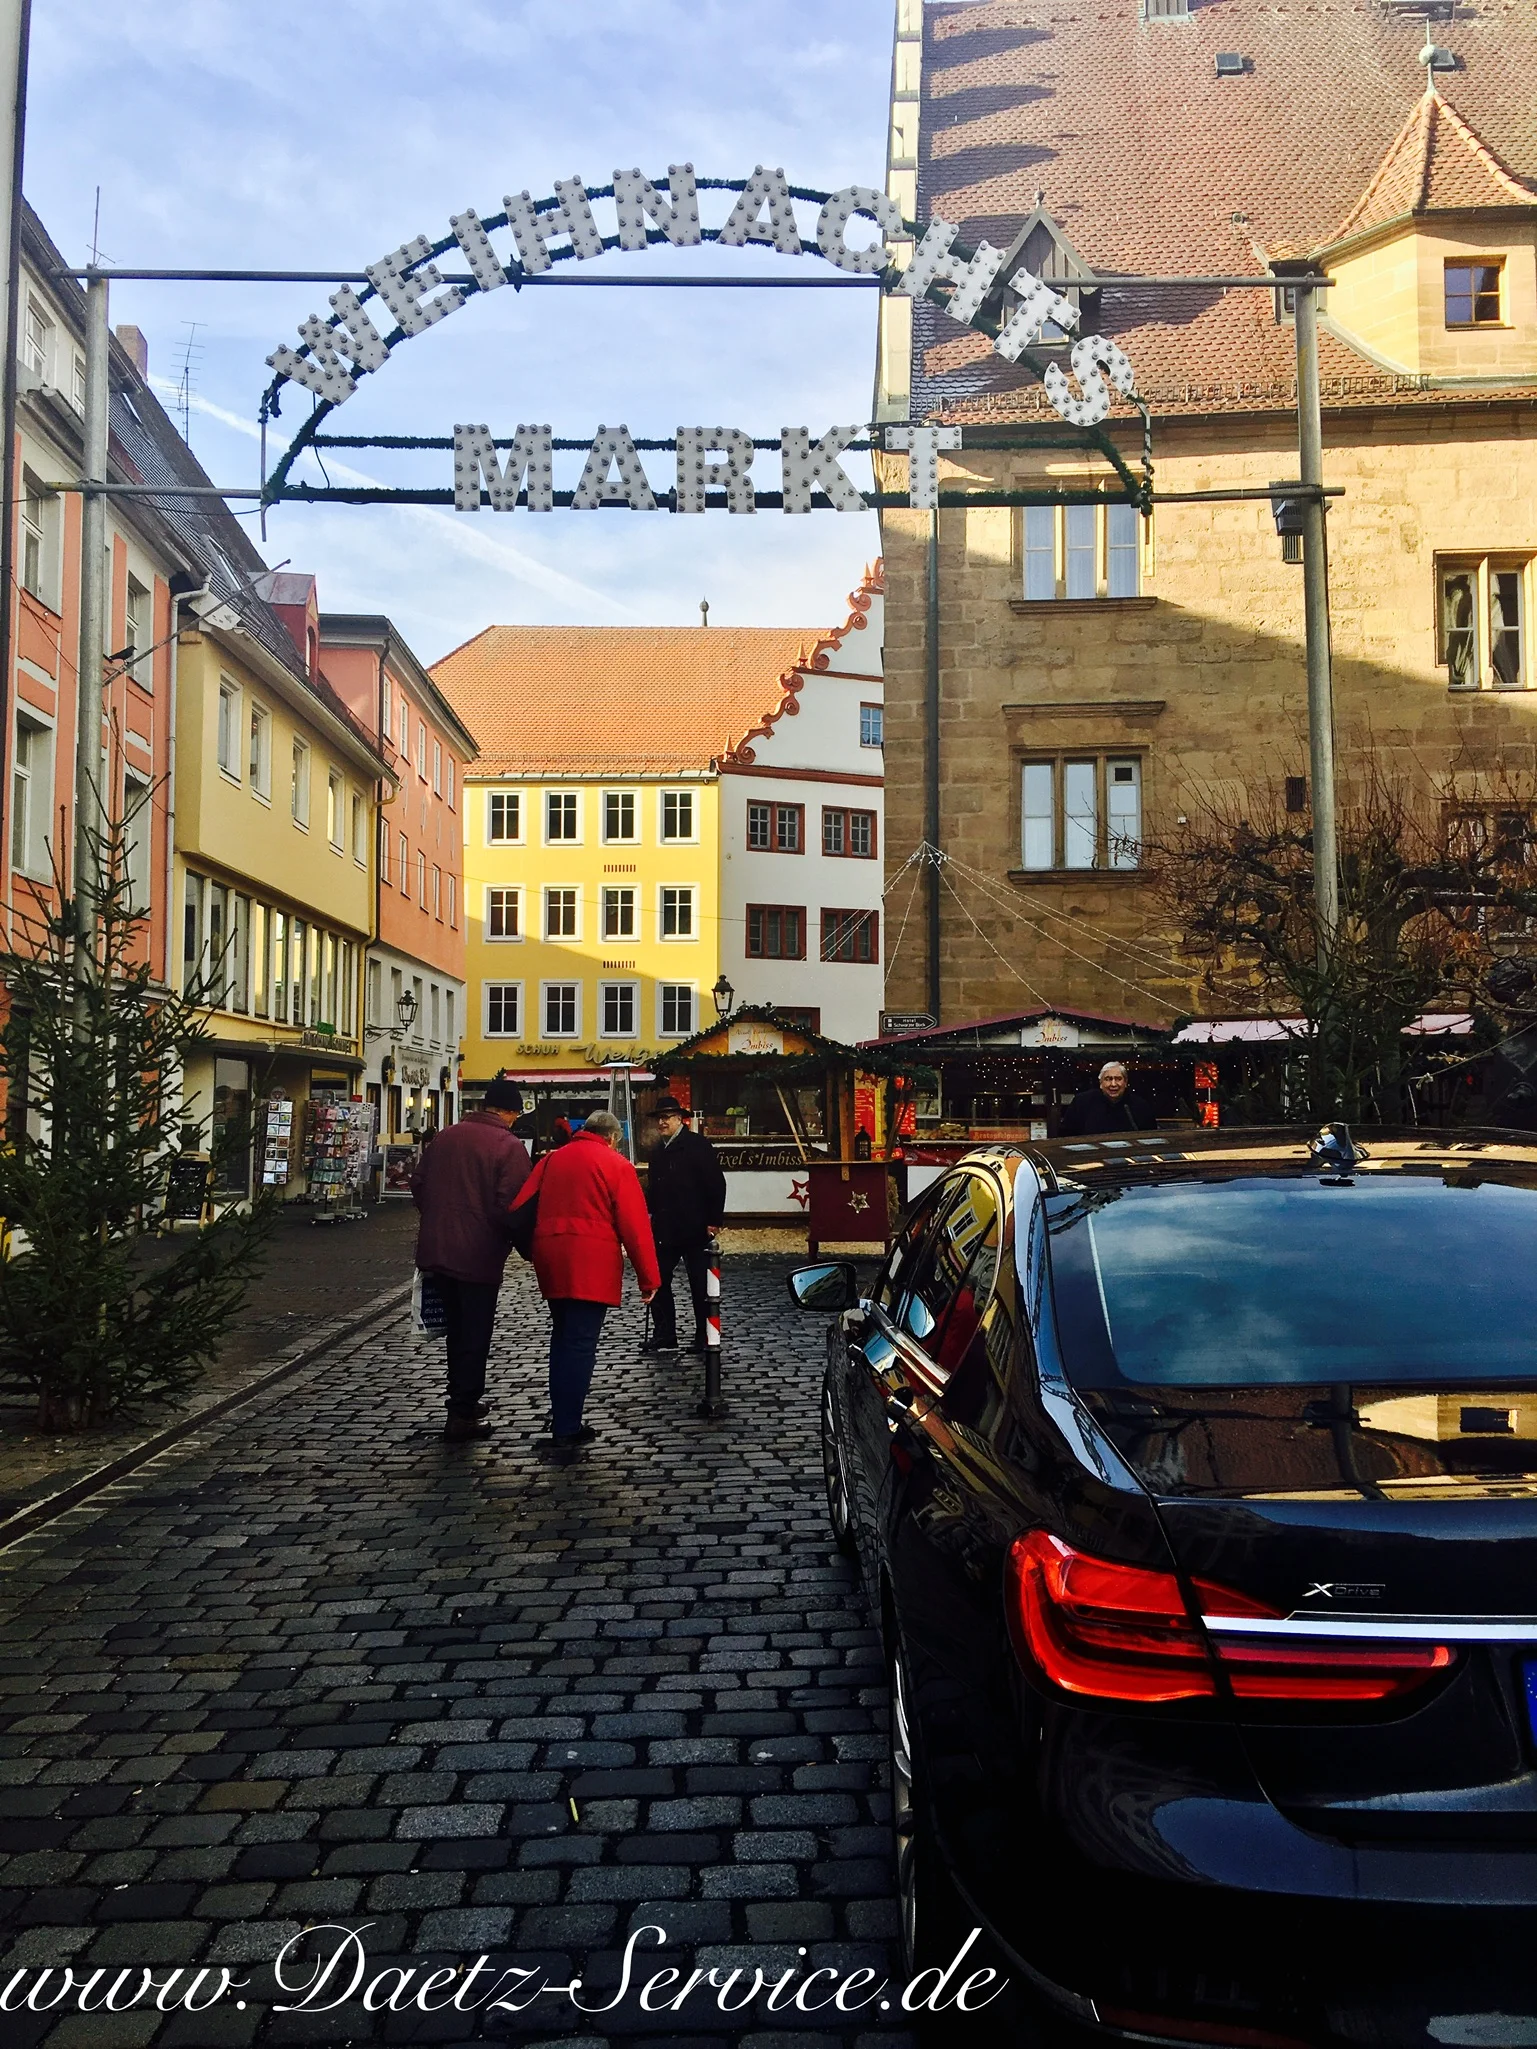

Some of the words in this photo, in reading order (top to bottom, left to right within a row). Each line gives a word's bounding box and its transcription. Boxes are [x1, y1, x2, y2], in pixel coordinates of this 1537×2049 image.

[265, 162, 1134, 426] WEIHNACHTS
[453, 423, 962, 514] MARKT
[1035, 1031, 1068, 1043] Imbiss
[515, 1043, 560, 1055] SCHUH
[741, 1039, 774, 1052] Imbiss
